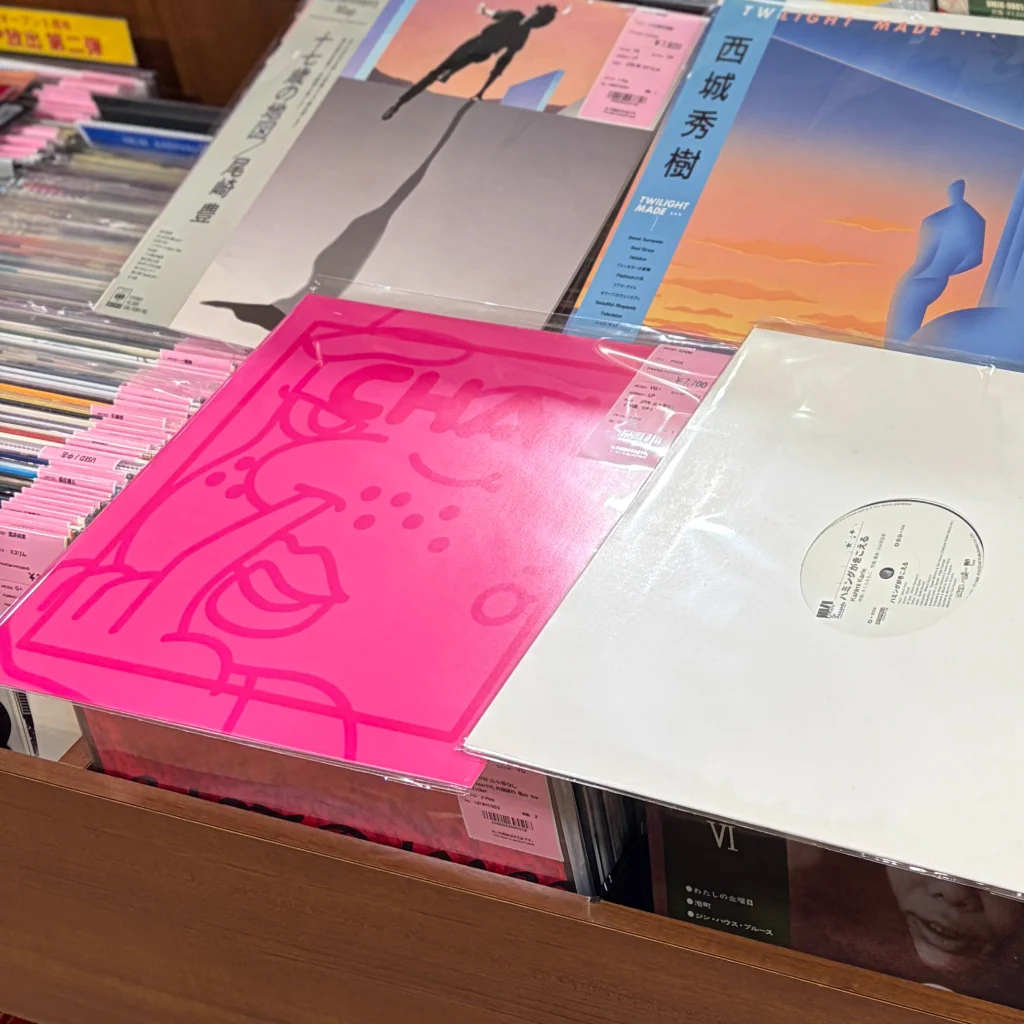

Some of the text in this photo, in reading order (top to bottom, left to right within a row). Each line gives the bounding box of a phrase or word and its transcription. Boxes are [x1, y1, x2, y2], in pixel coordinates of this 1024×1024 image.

[664, 35, 753, 180] 西城秀樹
[635, 204, 667, 216] MADE
[639, 195, 690, 210] TWILIGHT
[707, 819, 738, 852] VI
[694, 887, 754, 907] わたしの金曜日
[694, 899, 711, 910] 港町
